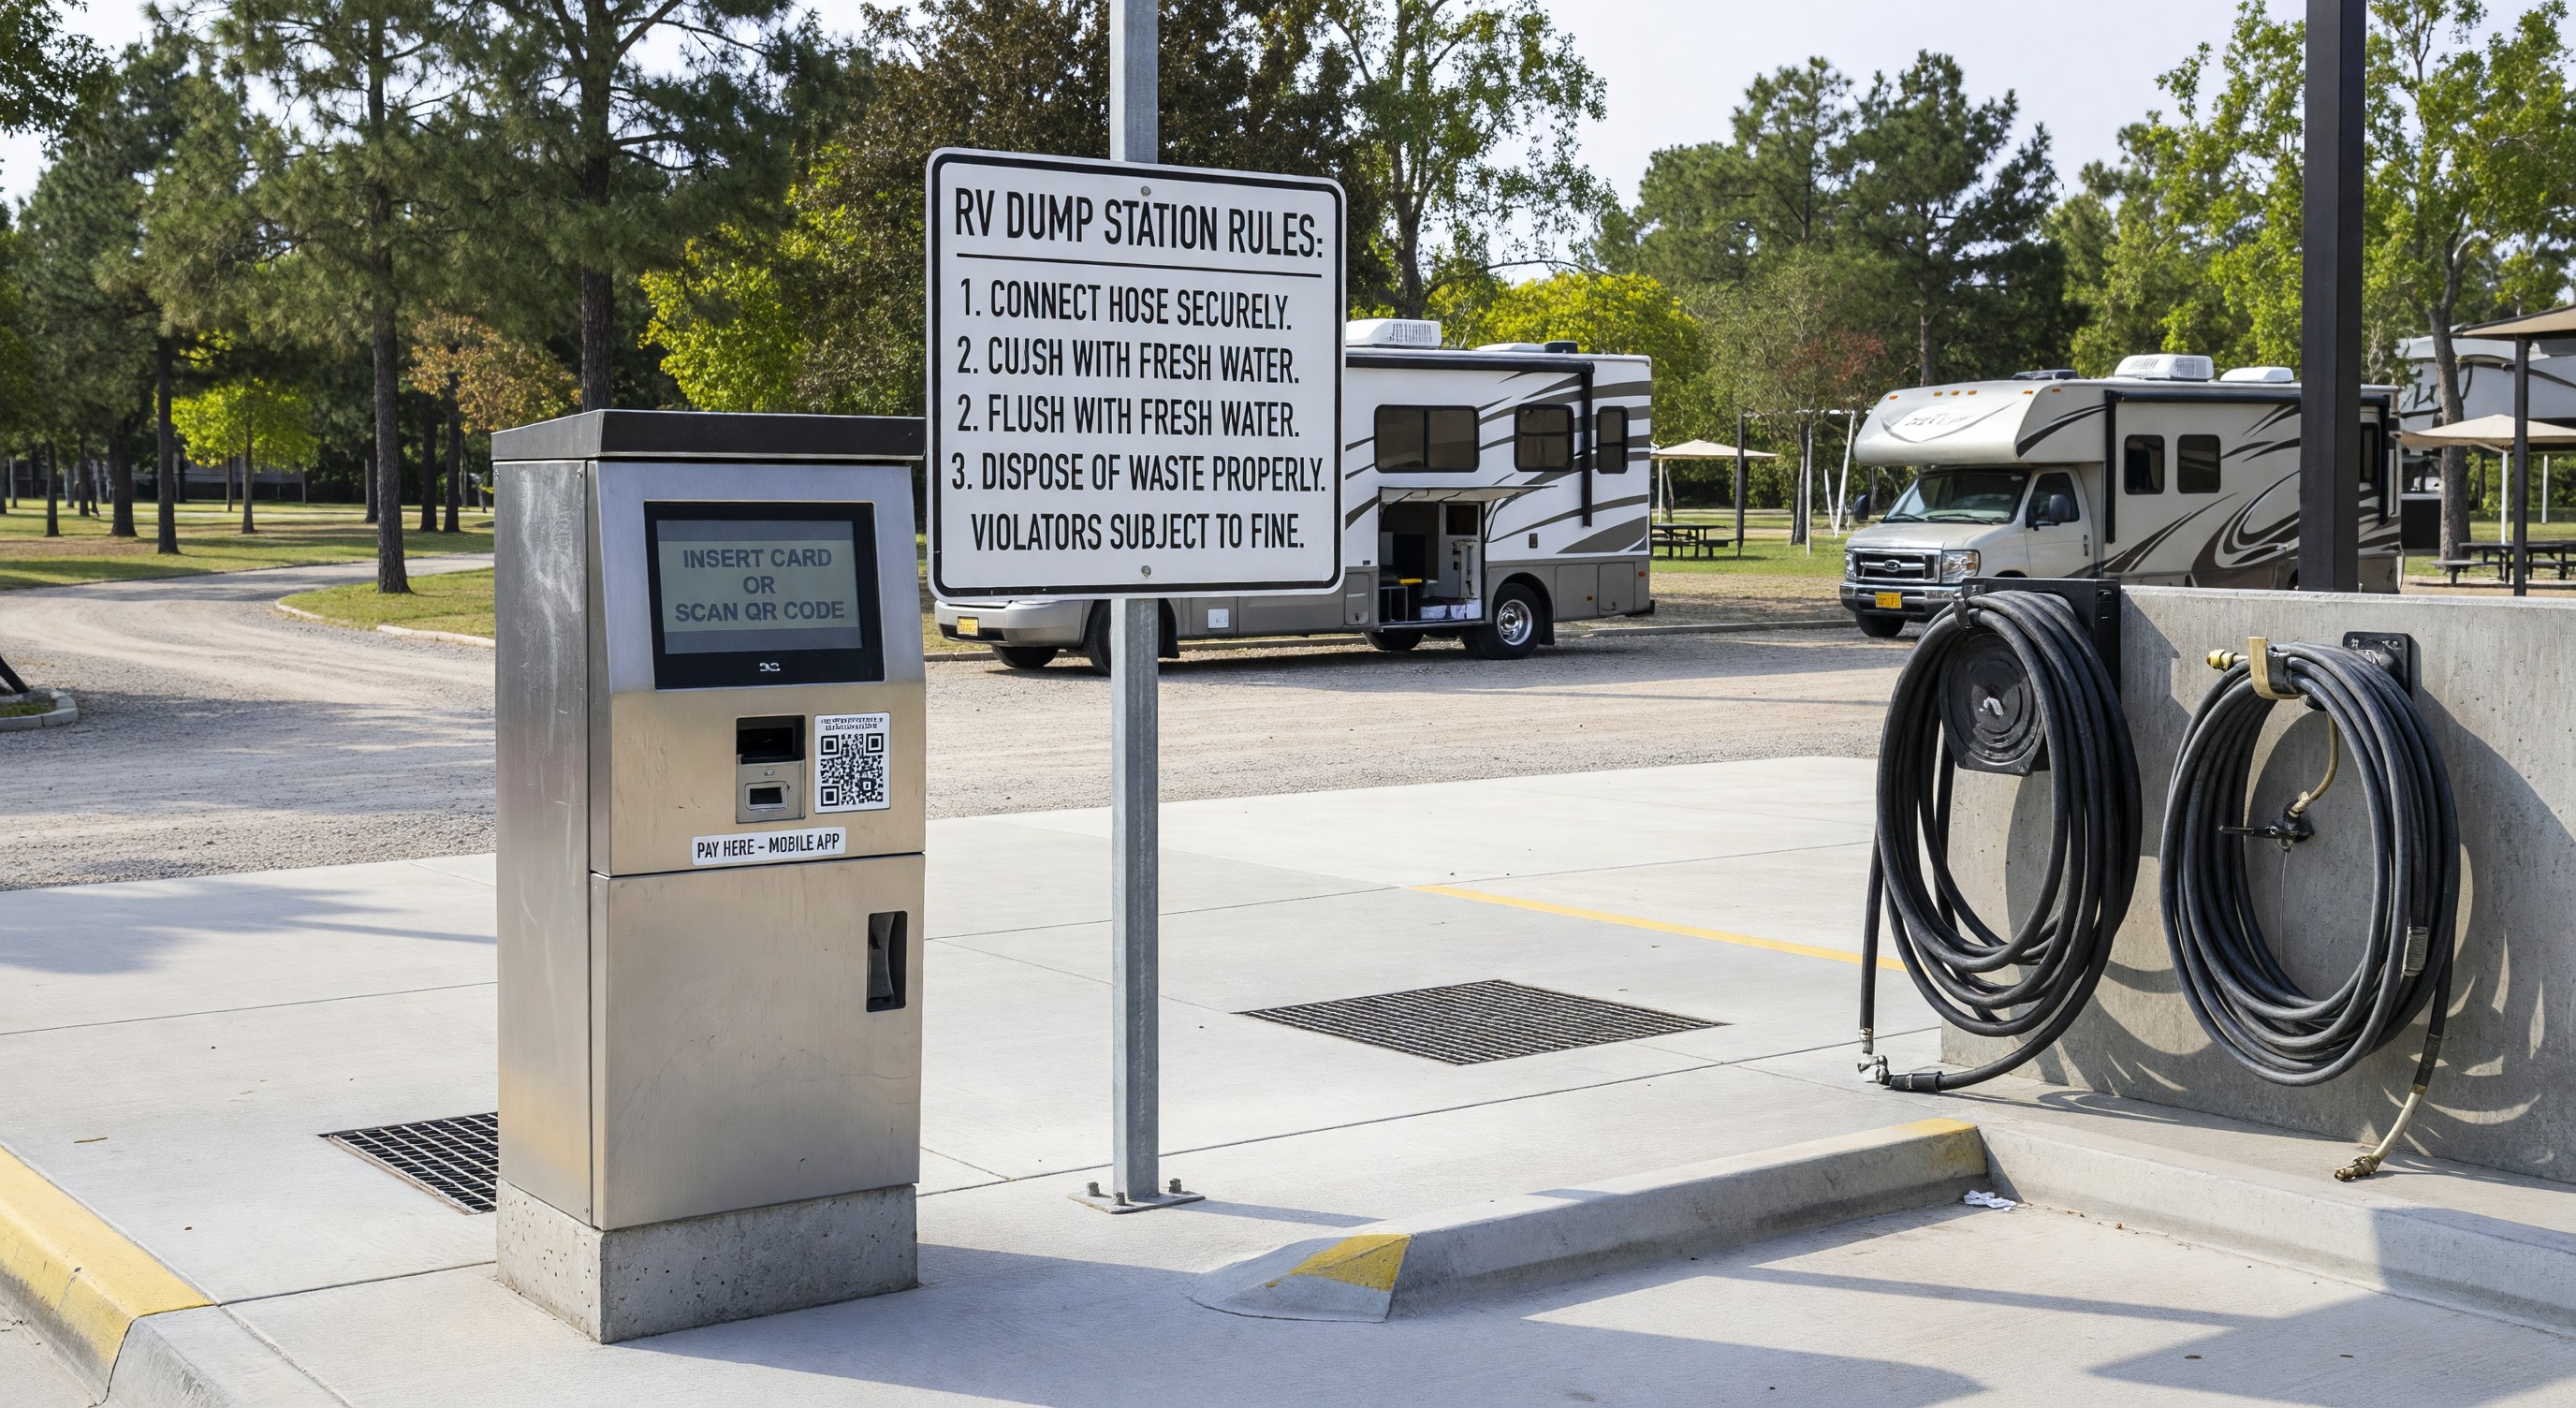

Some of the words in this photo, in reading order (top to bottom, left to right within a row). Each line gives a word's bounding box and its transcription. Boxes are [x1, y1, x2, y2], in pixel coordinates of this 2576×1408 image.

[956, 187, 996, 237] RV
[1007, 191, 1093, 242] DUMP
[1105, 198, 1218, 252] STATION
[1229, 208, 1323, 258] RULES:
[960, 278, 981, 316] 1.
[990, 279, 1102, 322] CONNECT
[1109, 286, 1169, 325] HOSE
[1177, 288, 1293, 330] SECURELY.
[957, 335, 979, 374] 2.
[1072, 339, 1131, 378] WITH
[1139, 342, 1211, 381] FRESH
[1219, 345, 1300, 385] WATER.
[958, 393, 979, 432] 2.
[988, 393, 1064, 433] FLUSH
[1073, 396, 1132, 434] WITH
[1140, 398, 1212, 436] FRESH
[1221, 400, 1300, 438] WATER.
[951, 451, 973, 491] 3.
[982, 452, 1084, 491] DISPOSE
[1091, 453, 1121, 491] OF
[1128, 454, 1205, 491] WASTE
[1212, 455, 1327, 492] PROPERLY.
[971, 513, 1102, 550] VIOLATORS
[1109, 513, 1210, 550] SUBJECT
[1215, 513, 1242, 549] TO
[1251, 512, 1306, 549] FINE.
[682, 549, 765, 568] INSERT
[769, 548, 832, 567] CARD
[742, 576, 776, 594] OR
[675, 603, 739, 623] SCAN
[744, 602, 778, 622] QR
[783, 600, 845, 620] CODE
[697, 841, 720, 858] PAY
[723, 838, 755, 857] HERE
[768, 834, 814, 854] MOBILE
[816, 832, 840, 850] APP
